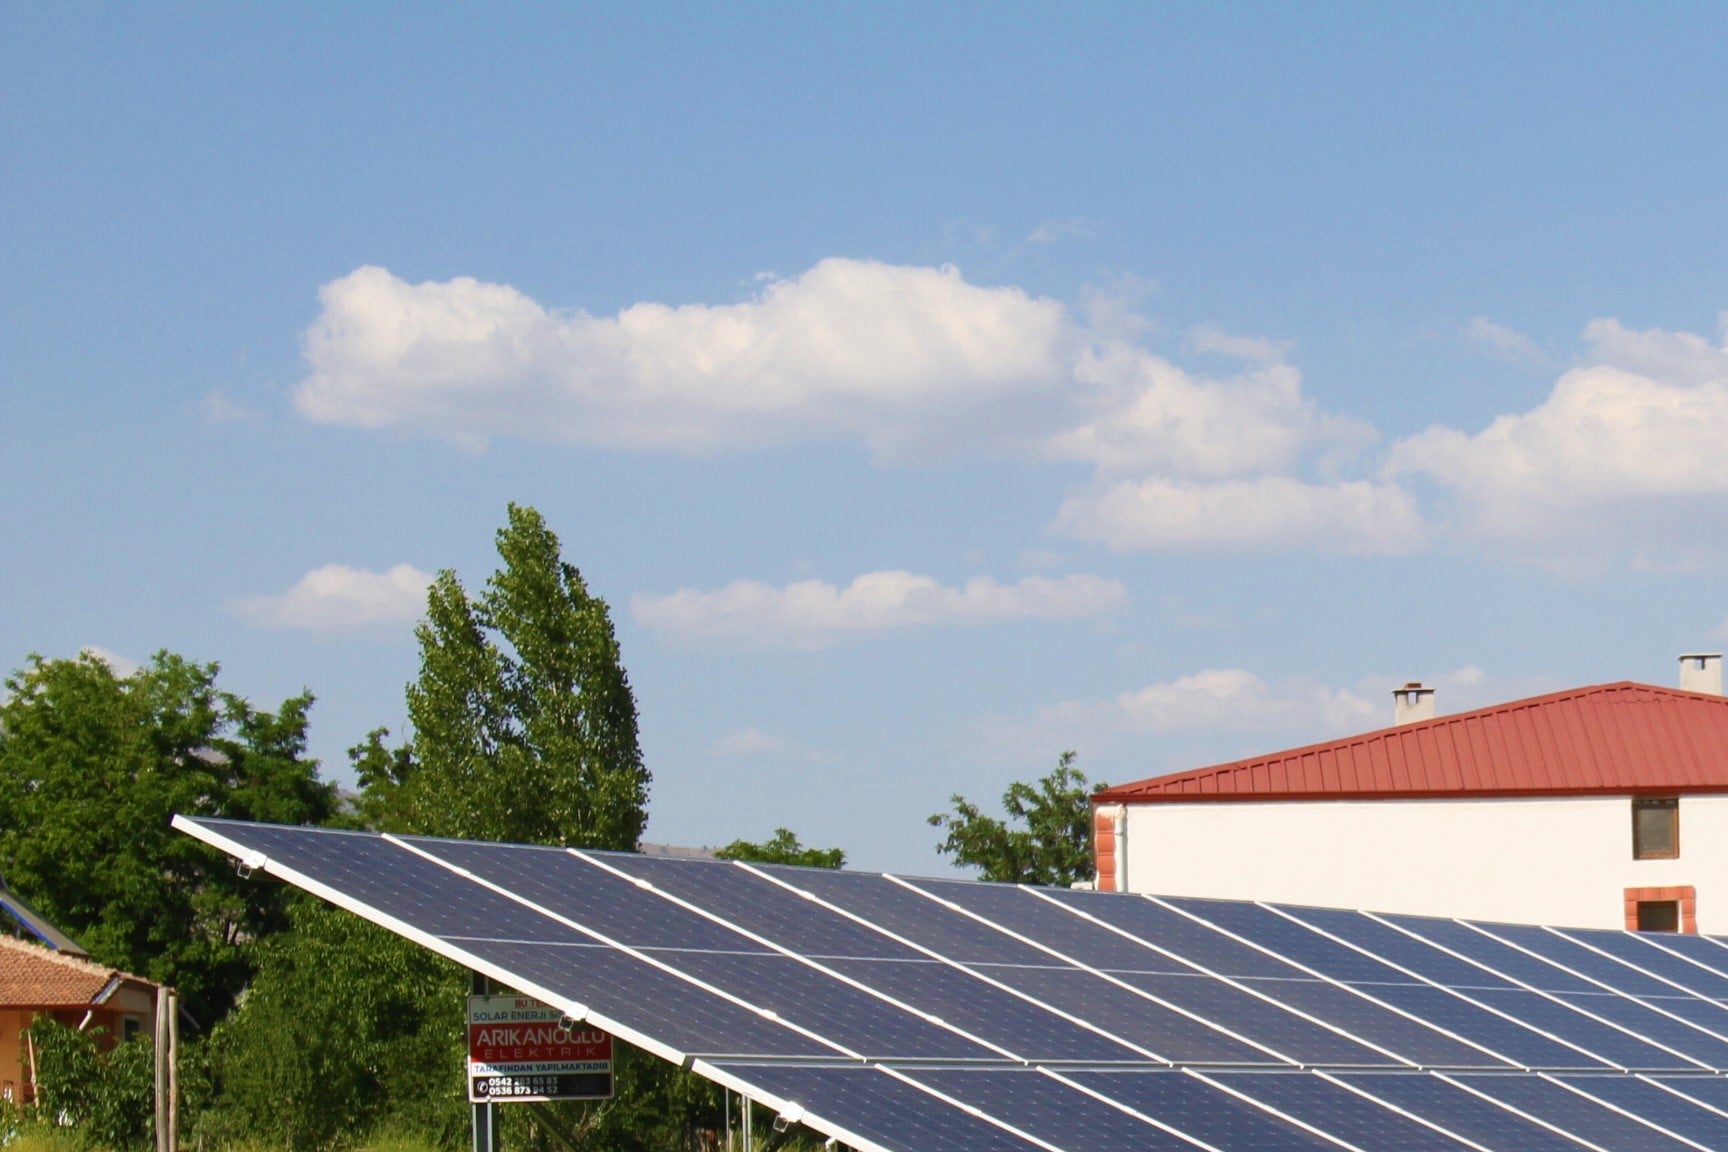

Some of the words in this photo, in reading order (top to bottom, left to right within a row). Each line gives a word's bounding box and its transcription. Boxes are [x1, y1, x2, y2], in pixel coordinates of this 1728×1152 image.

[514, 999, 528, 1008] BU
[473, 1012, 508, 1021] SOLAR
[474, 1064, 533, 1073] TARAFINDAN
[489, 1077, 512, 1086] 0542
[489, 1086, 512, 1095] 0536
[514, 1086, 531, 1095] 873
